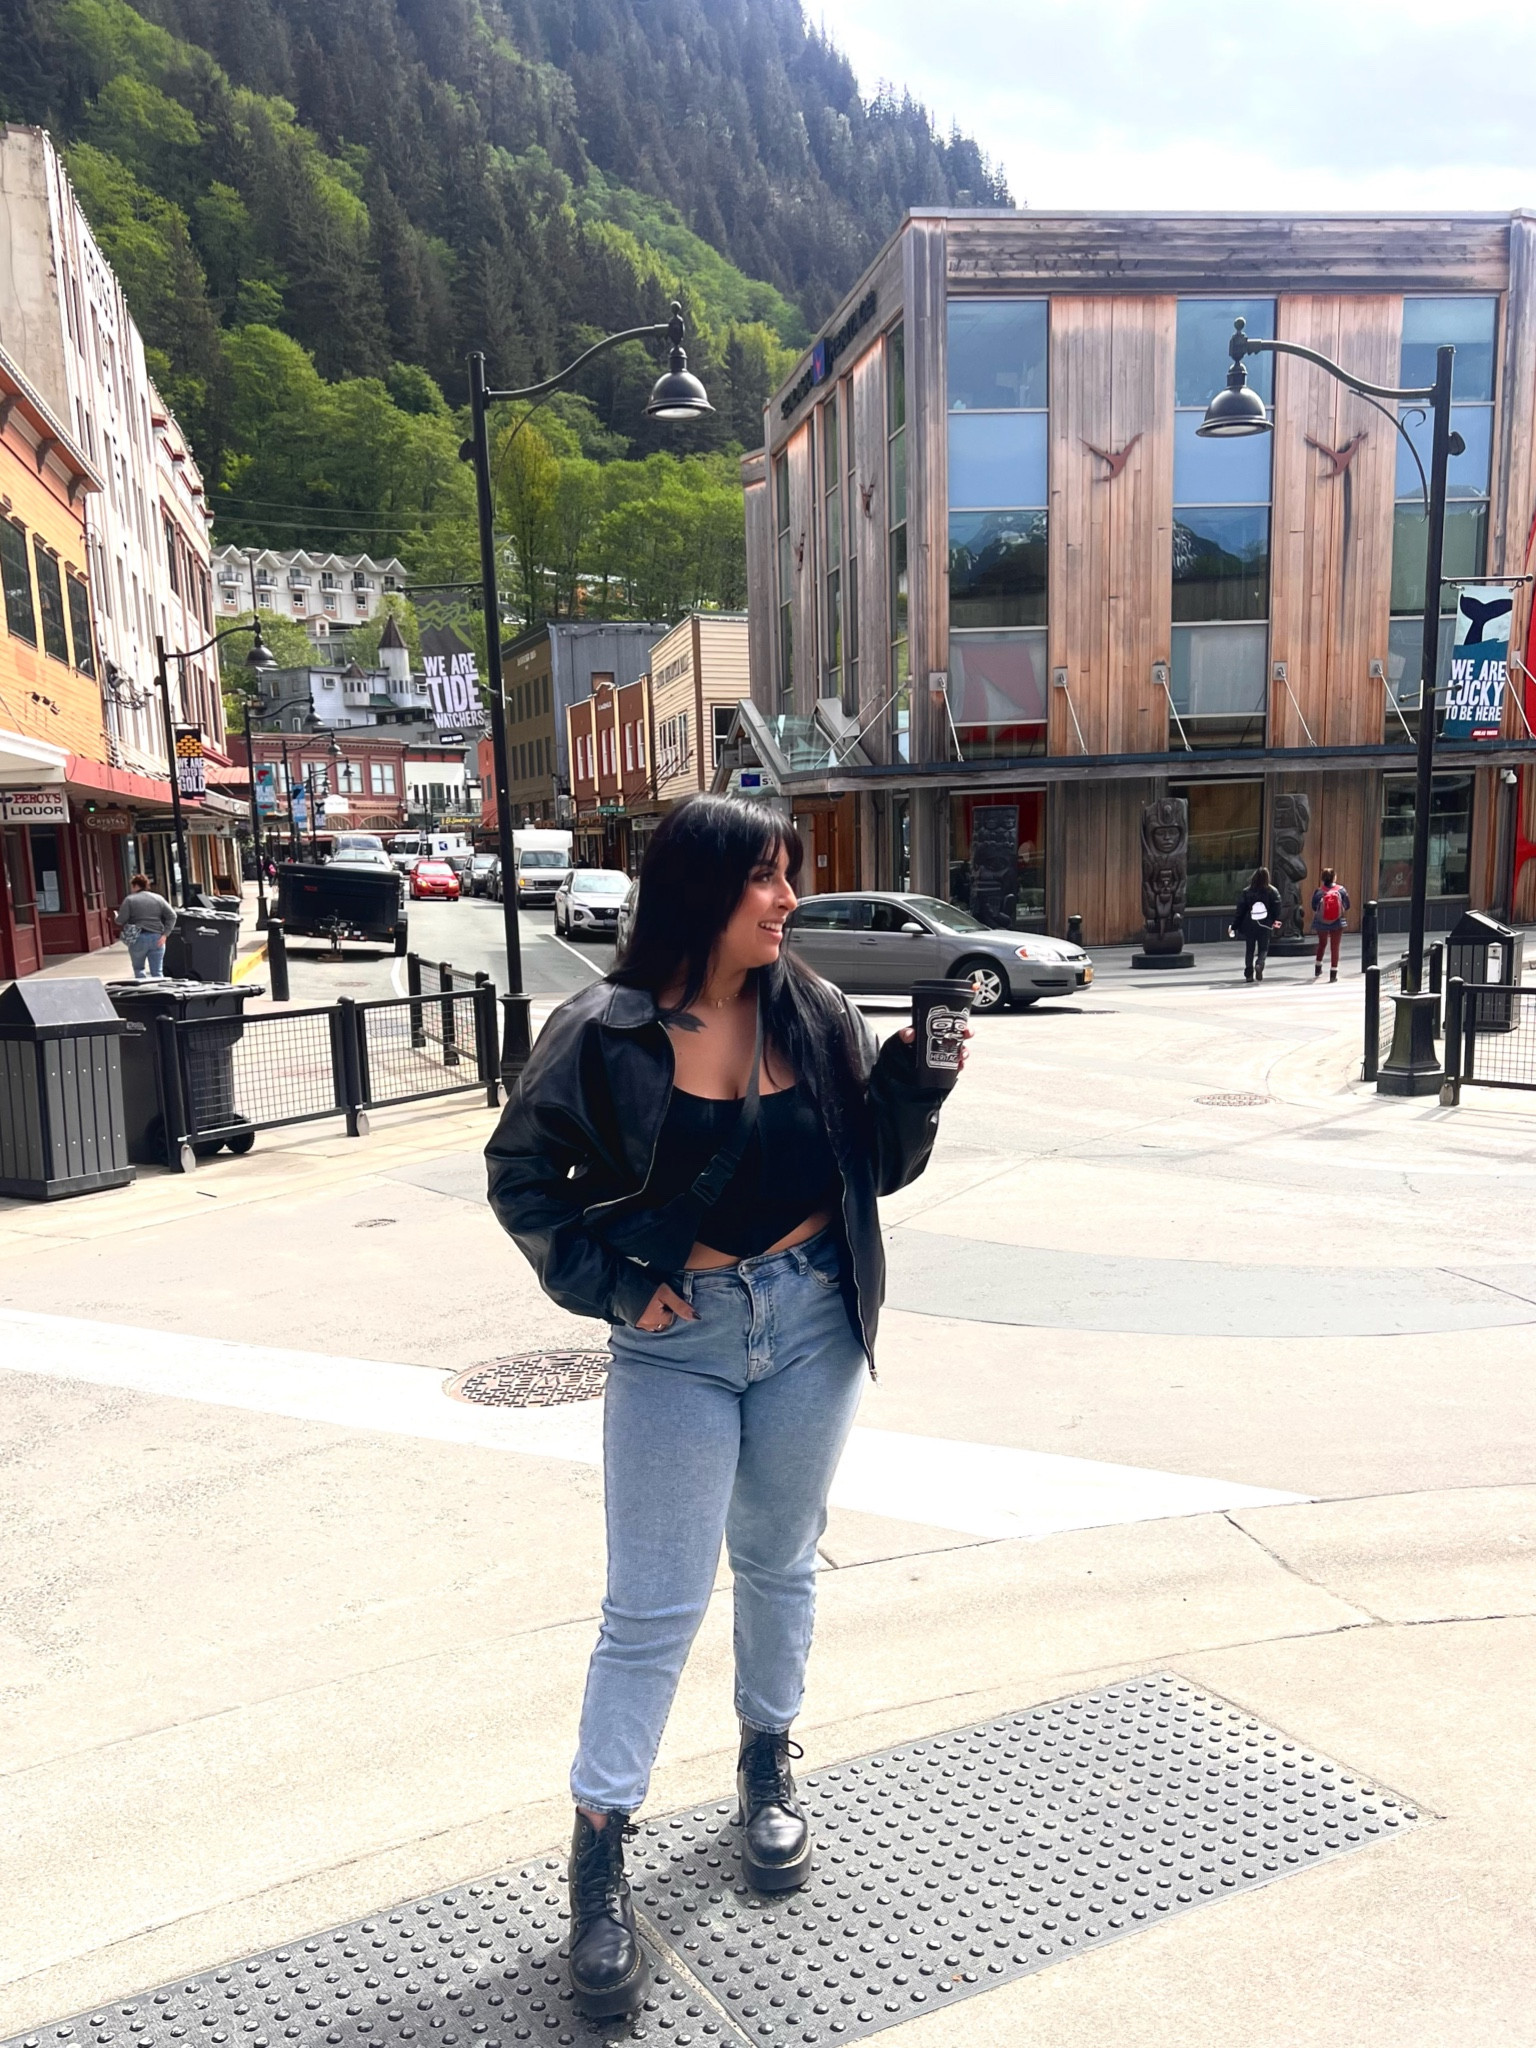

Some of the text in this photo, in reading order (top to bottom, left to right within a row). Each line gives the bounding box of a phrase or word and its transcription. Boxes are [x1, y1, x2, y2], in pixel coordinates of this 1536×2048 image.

[423, 652, 478, 677] WE ARE
[1451, 659, 1507, 681] WE ARE
[426, 673, 484, 713] TIDE
[1445, 680, 1506, 706] LUCKY
[433, 710, 485, 729] WATCHERS
[1445, 705, 1503, 721] TO BE HERE
[178, 758, 204, 768] WE ARE
[180, 776, 205, 792] GOLD
[12, 793, 62, 804] PERCY'S
[11, 806, 63, 815] LIQUOR
